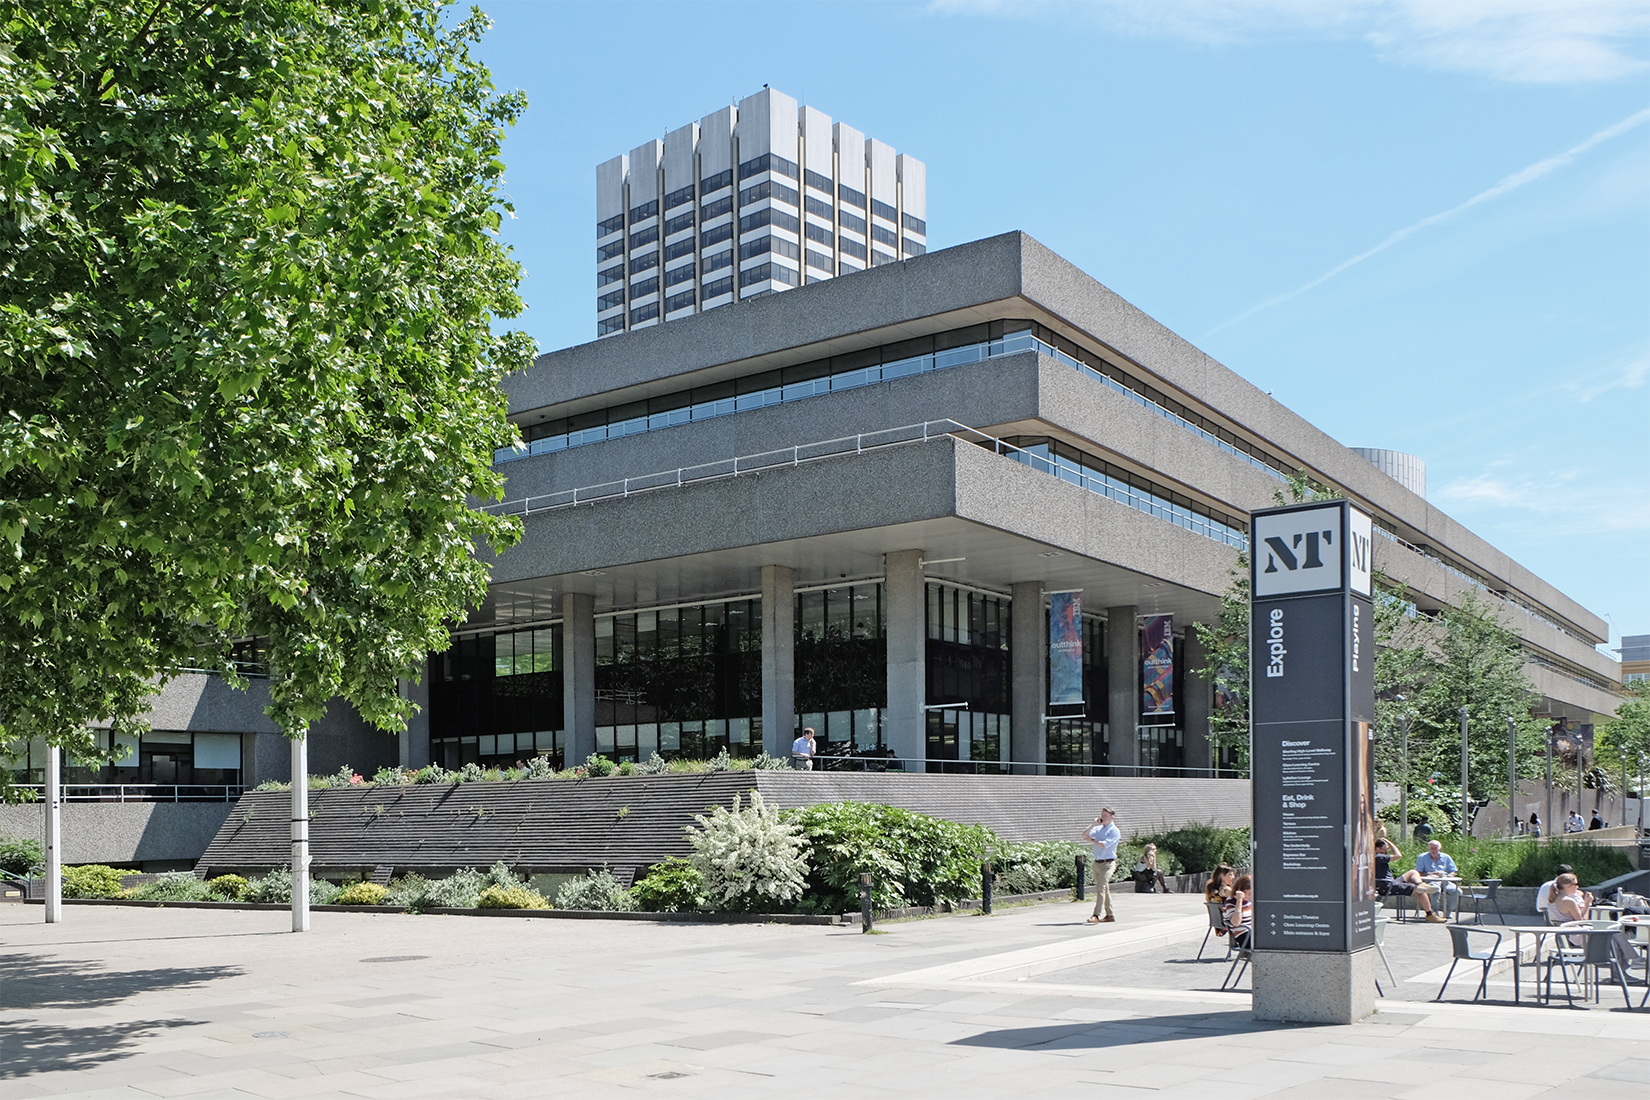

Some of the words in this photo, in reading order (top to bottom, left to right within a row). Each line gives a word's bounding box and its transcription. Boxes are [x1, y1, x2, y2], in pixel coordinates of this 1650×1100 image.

[1264, 530, 1332, 573] NT
[1352, 530, 1369, 573] NT
[1072, 598, 1081, 616] IBM
[1163, 620, 1172, 637] IBM
[1266, 608, 1287, 678] Explore
[1352, 604, 1360, 672] Playing
[1051, 640, 1082, 649] outthink
[1144, 658, 1172, 666] outthink
